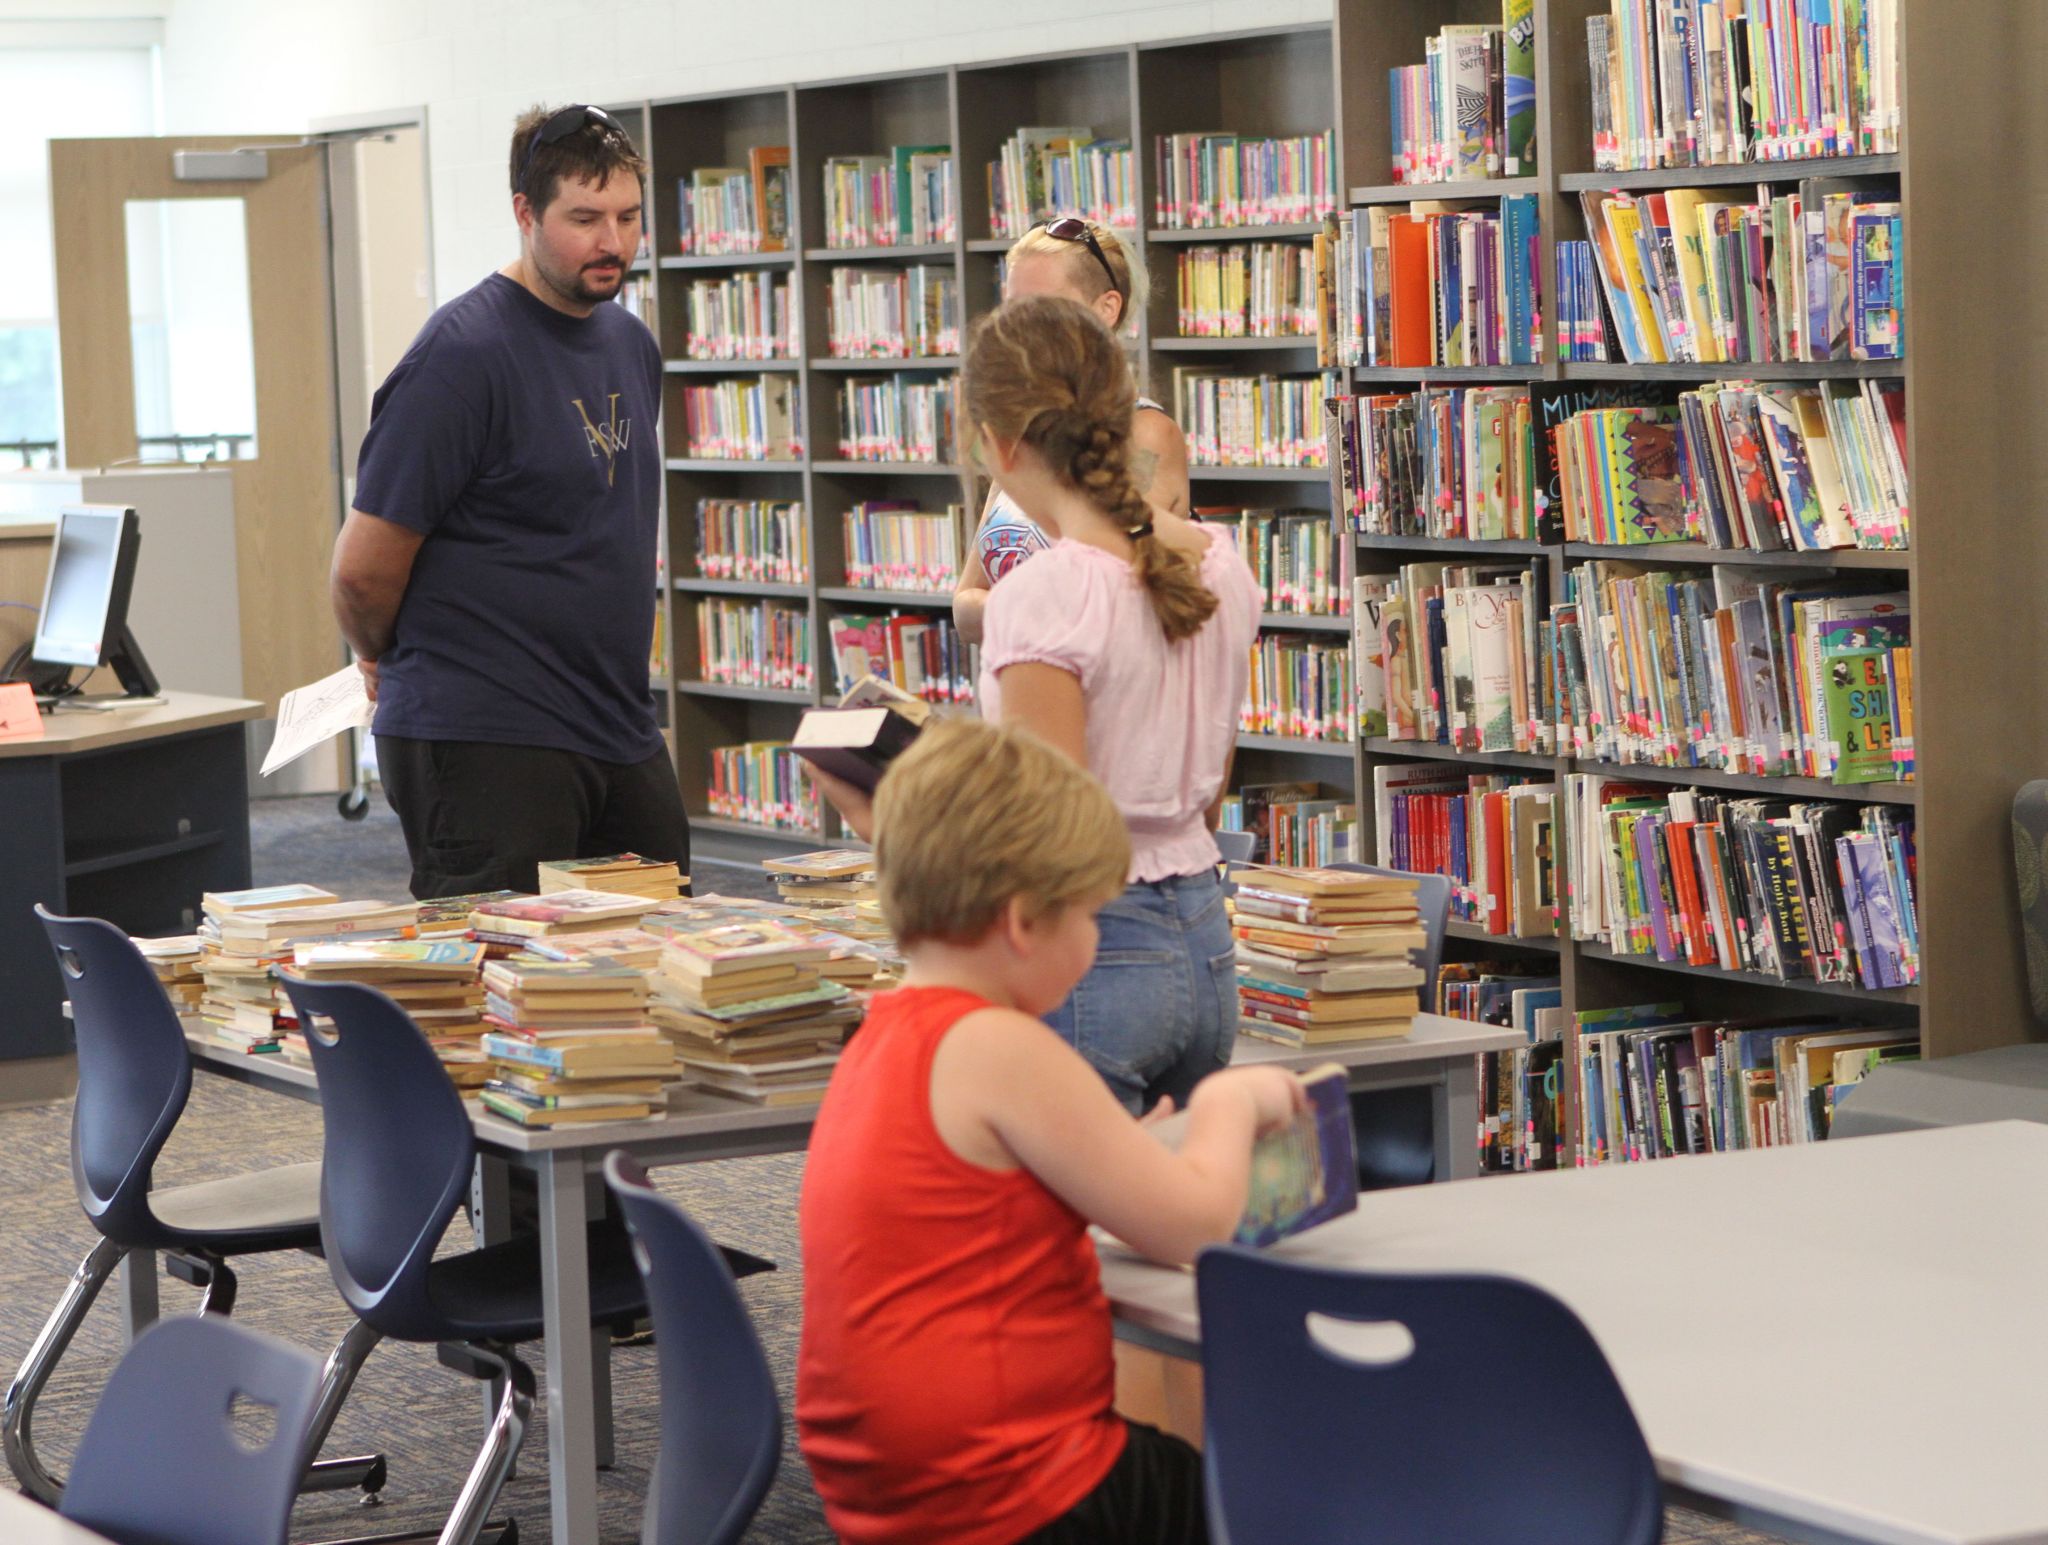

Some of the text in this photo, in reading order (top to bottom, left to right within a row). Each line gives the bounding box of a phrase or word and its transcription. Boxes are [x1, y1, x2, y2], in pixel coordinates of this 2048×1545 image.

[1849, 689, 1889, 720] SH
[1847, 730, 1859, 754] &
[1766, 856, 1778, 872] by
